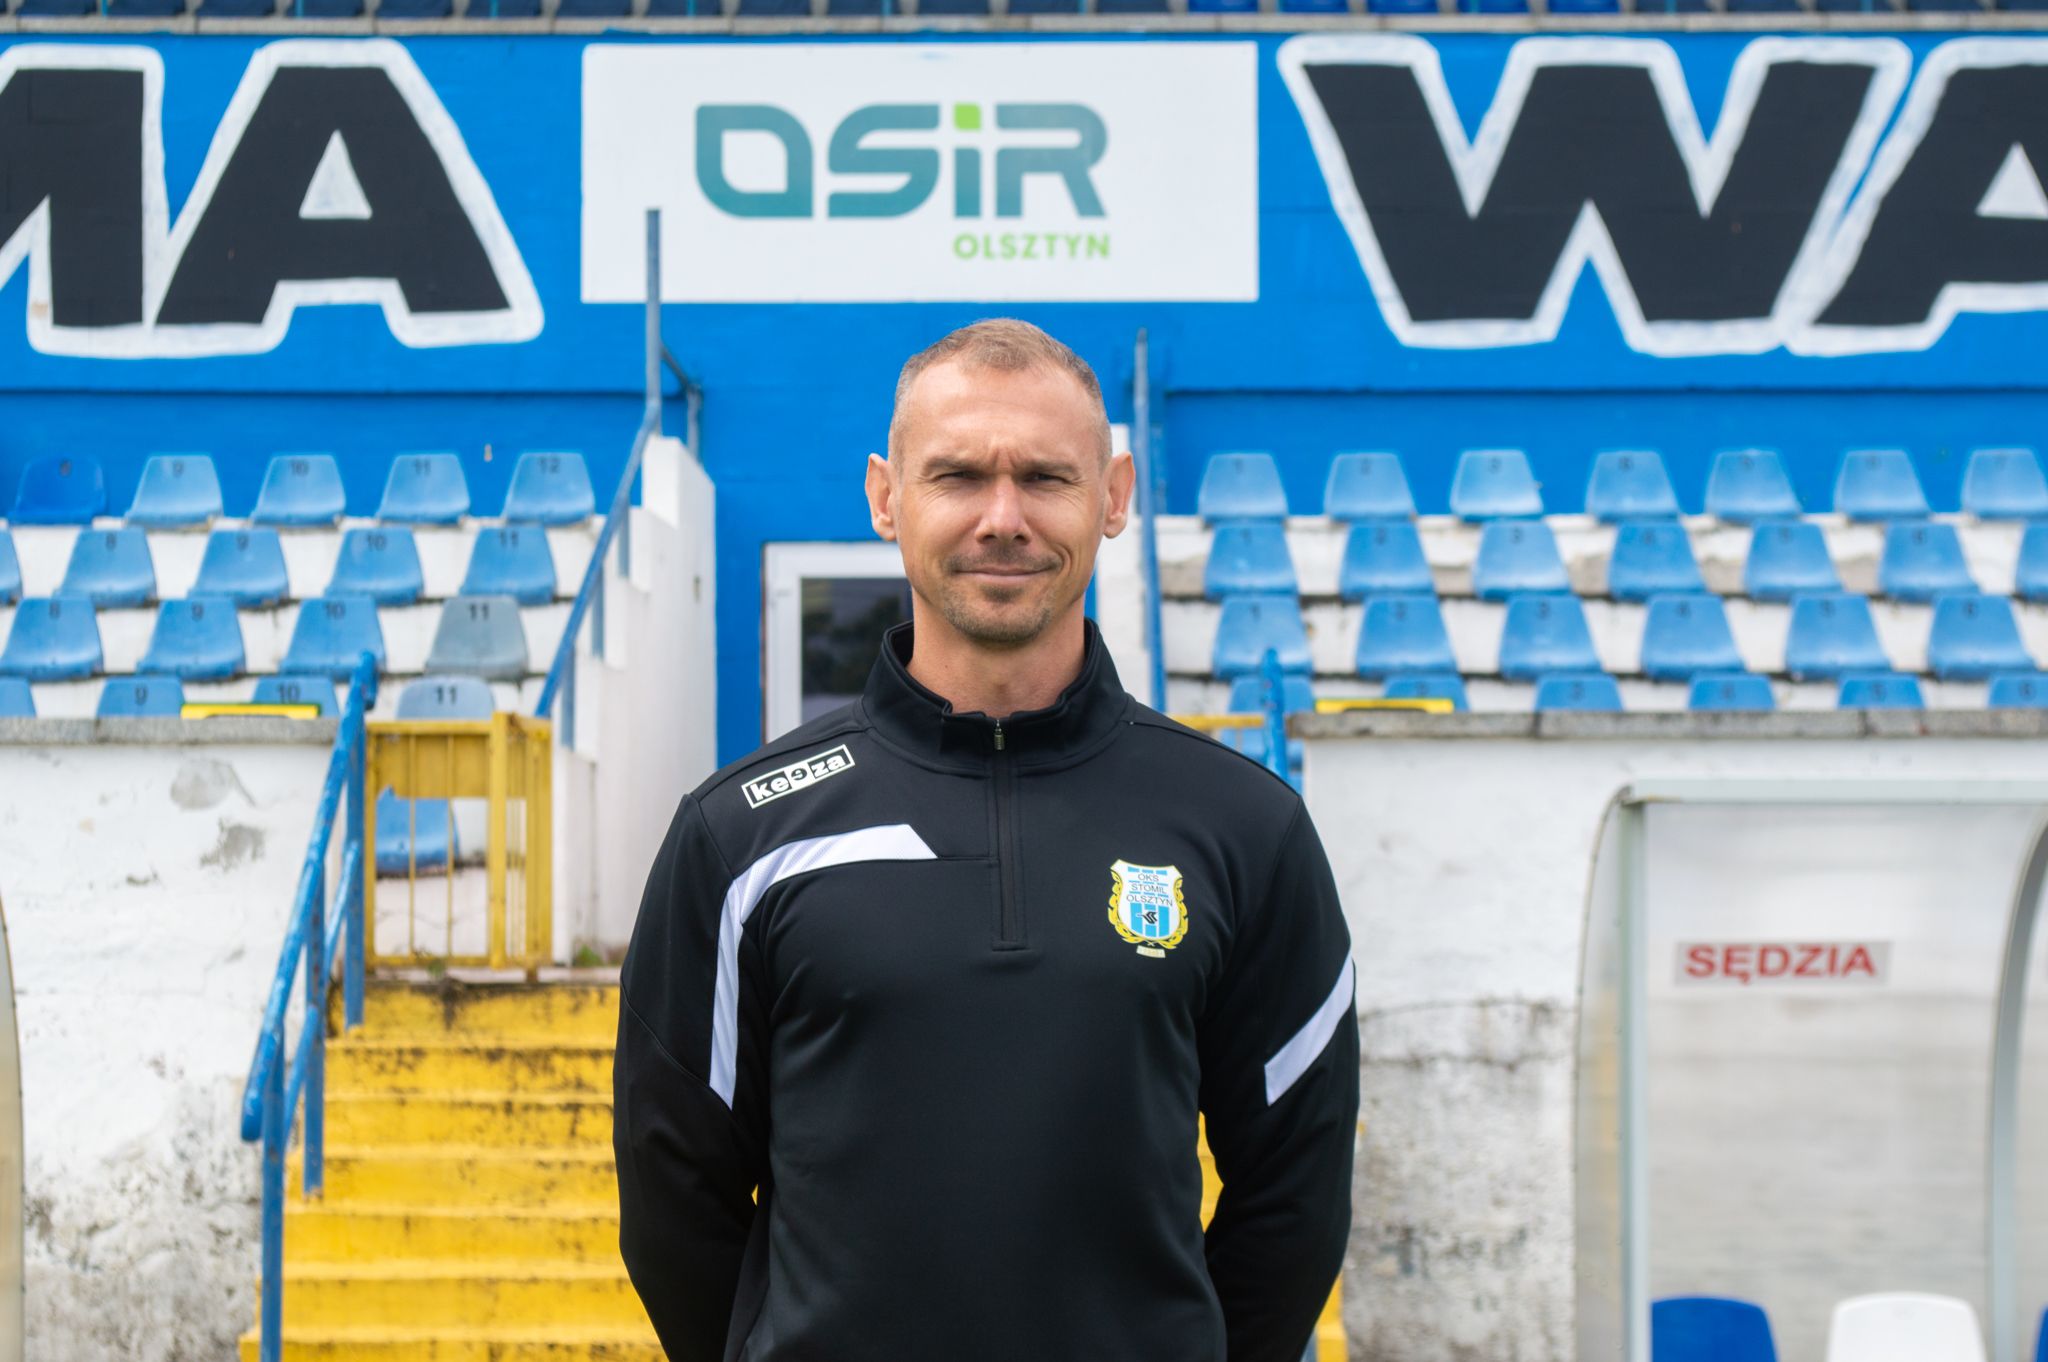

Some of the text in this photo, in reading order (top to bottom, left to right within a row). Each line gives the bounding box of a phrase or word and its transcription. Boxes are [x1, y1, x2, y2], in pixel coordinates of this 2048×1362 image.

[953, 233, 1111, 260] OLSZTYN
[538, 457, 560, 474] 12
[366, 532, 388, 551] 10
[499, 529, 520, 549] 11
[325, 600, 347, 620] 10
[467, 603, 490, 621] 11
[134, 685, 148, 705] 9
[277, 682, 300, 703] 10
[435, 685, 458, 705] 11
[1137, 872, 1160, 883] OKS
[1130, 883, 1168, 895] STOMIL
[1126, 894, 1174, 907] OLSZTYN
[1684, 943, 1877, 985] SĘDZIA
